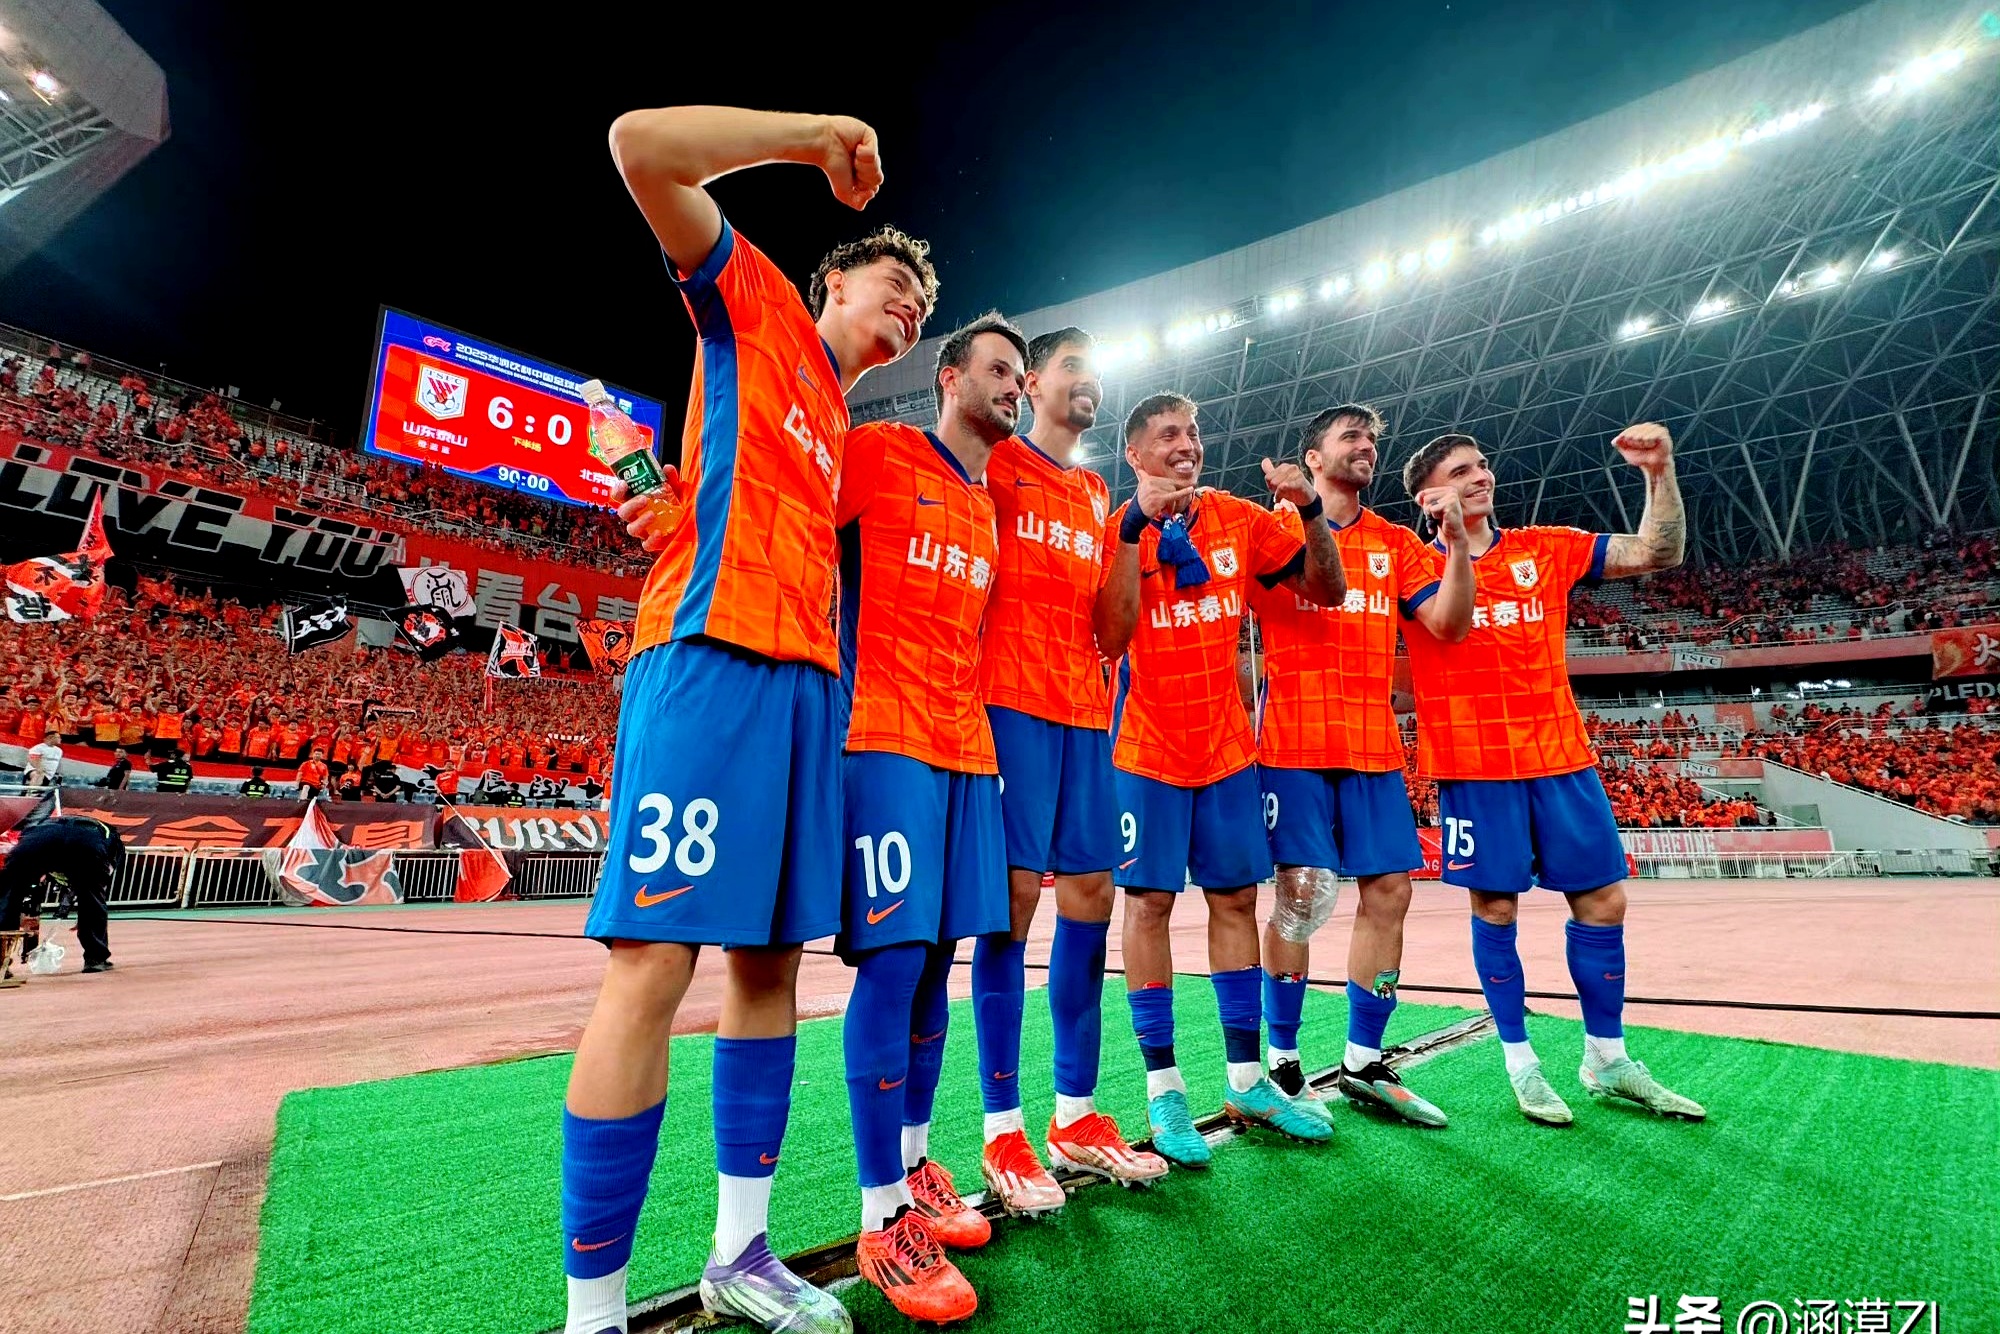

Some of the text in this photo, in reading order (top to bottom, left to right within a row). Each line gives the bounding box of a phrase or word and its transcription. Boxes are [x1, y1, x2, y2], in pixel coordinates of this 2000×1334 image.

[402, 421, 468, 448] 山东泰山
[512, 436, 542, 452] 下半场
[498, 466, 550, 492] 90:00
[258, 504, 399, 579] YOU
[1150, 589, 1241, 629] 山东泰山
[628, 792, 719, 877] 38
[1120, 811, 1137, 853] 9
[1445, 816, 1475, 858] 15
[854, 831, 912, 899] 10
